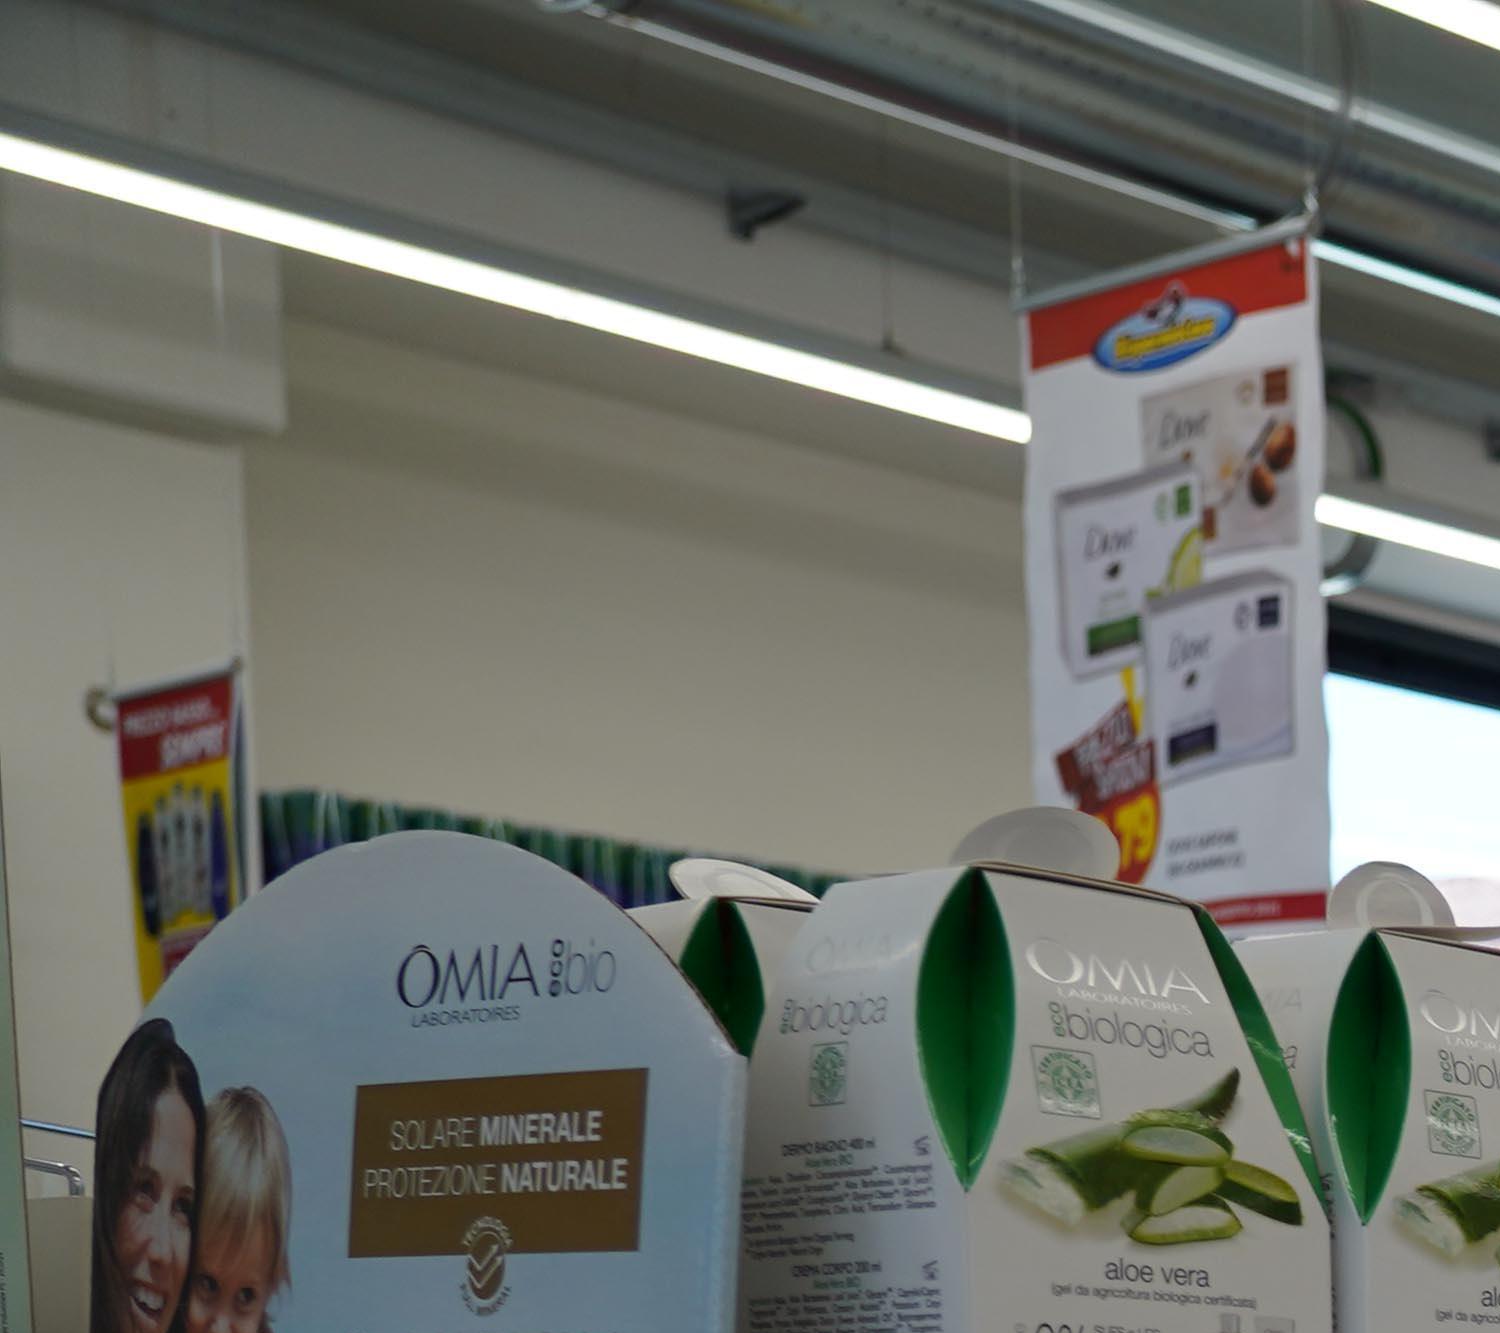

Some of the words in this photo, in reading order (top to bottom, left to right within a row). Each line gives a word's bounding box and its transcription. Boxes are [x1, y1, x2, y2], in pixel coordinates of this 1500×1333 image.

[564, 939, 617, 995] bio
[410, 1005, 521, 1029] LABORATOIRES
[1063, 1010, 1216, 1060] biologica
[390, 1118, 474, 1152] SOLARE
[479, 1111, 602, 1146] MINERALE
[363, 1167, 496, 1199] PROTEZIONE
[500, 1159, 628, 1192] NATURALE
[1104, 1259, 1154, 1284] aloe
[1160, 1263, 1210, 1289] vera
